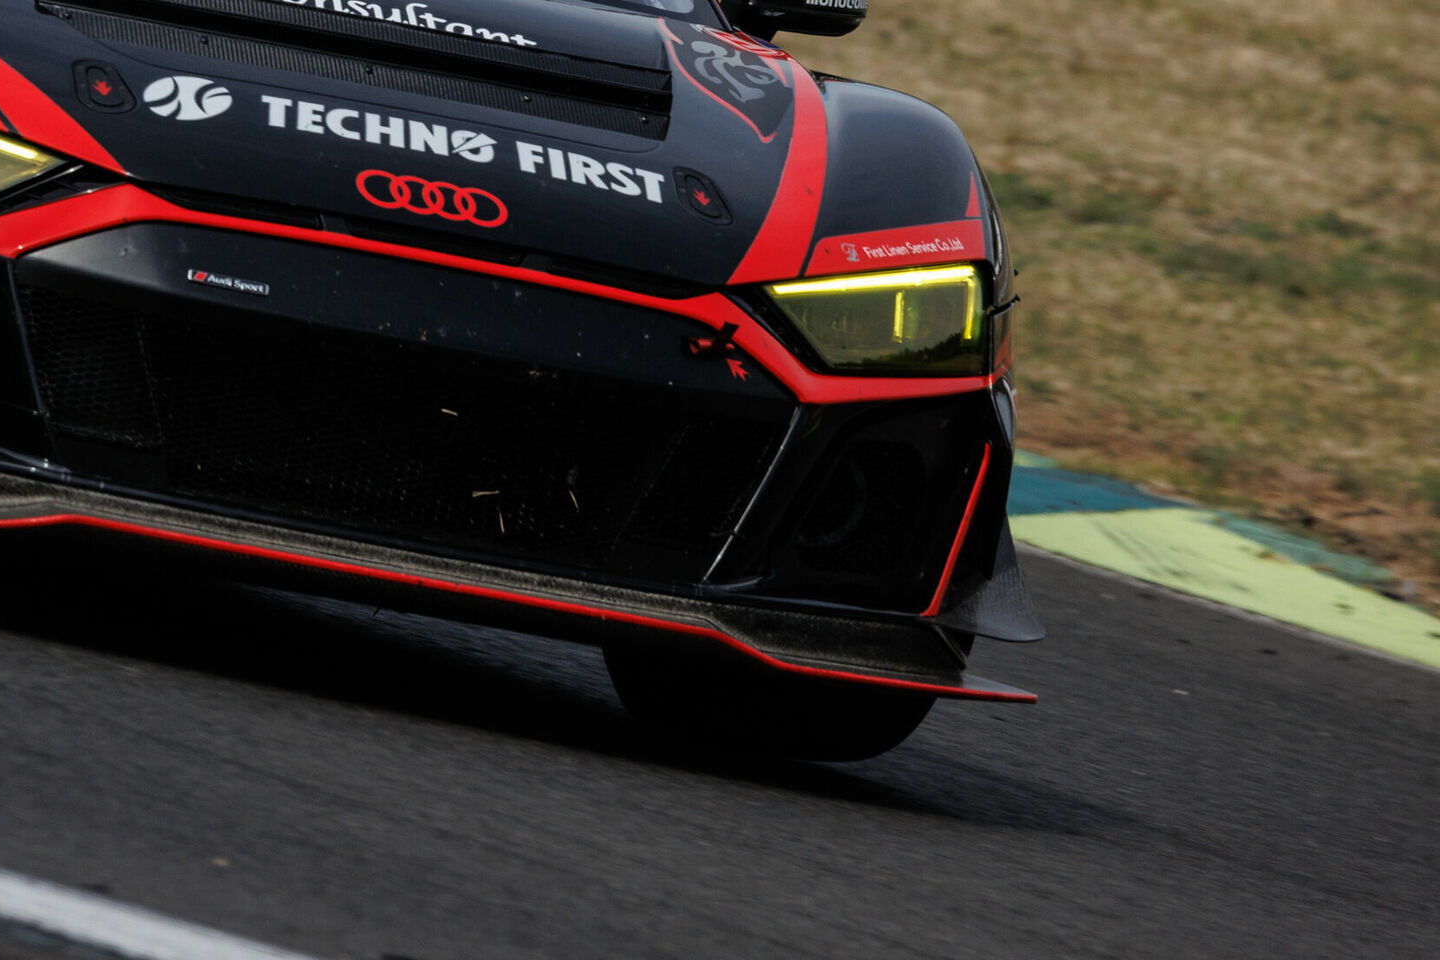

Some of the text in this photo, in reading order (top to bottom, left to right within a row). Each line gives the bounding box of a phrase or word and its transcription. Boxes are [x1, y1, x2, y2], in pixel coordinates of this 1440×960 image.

[516, 140, 665, 204] FIRST
[862, 245, 886, 259] First
[882, 244, 909, 257] Linen
[905, 240, 938, 255] Service
[207, 273, 265, 293] Audi Sport
